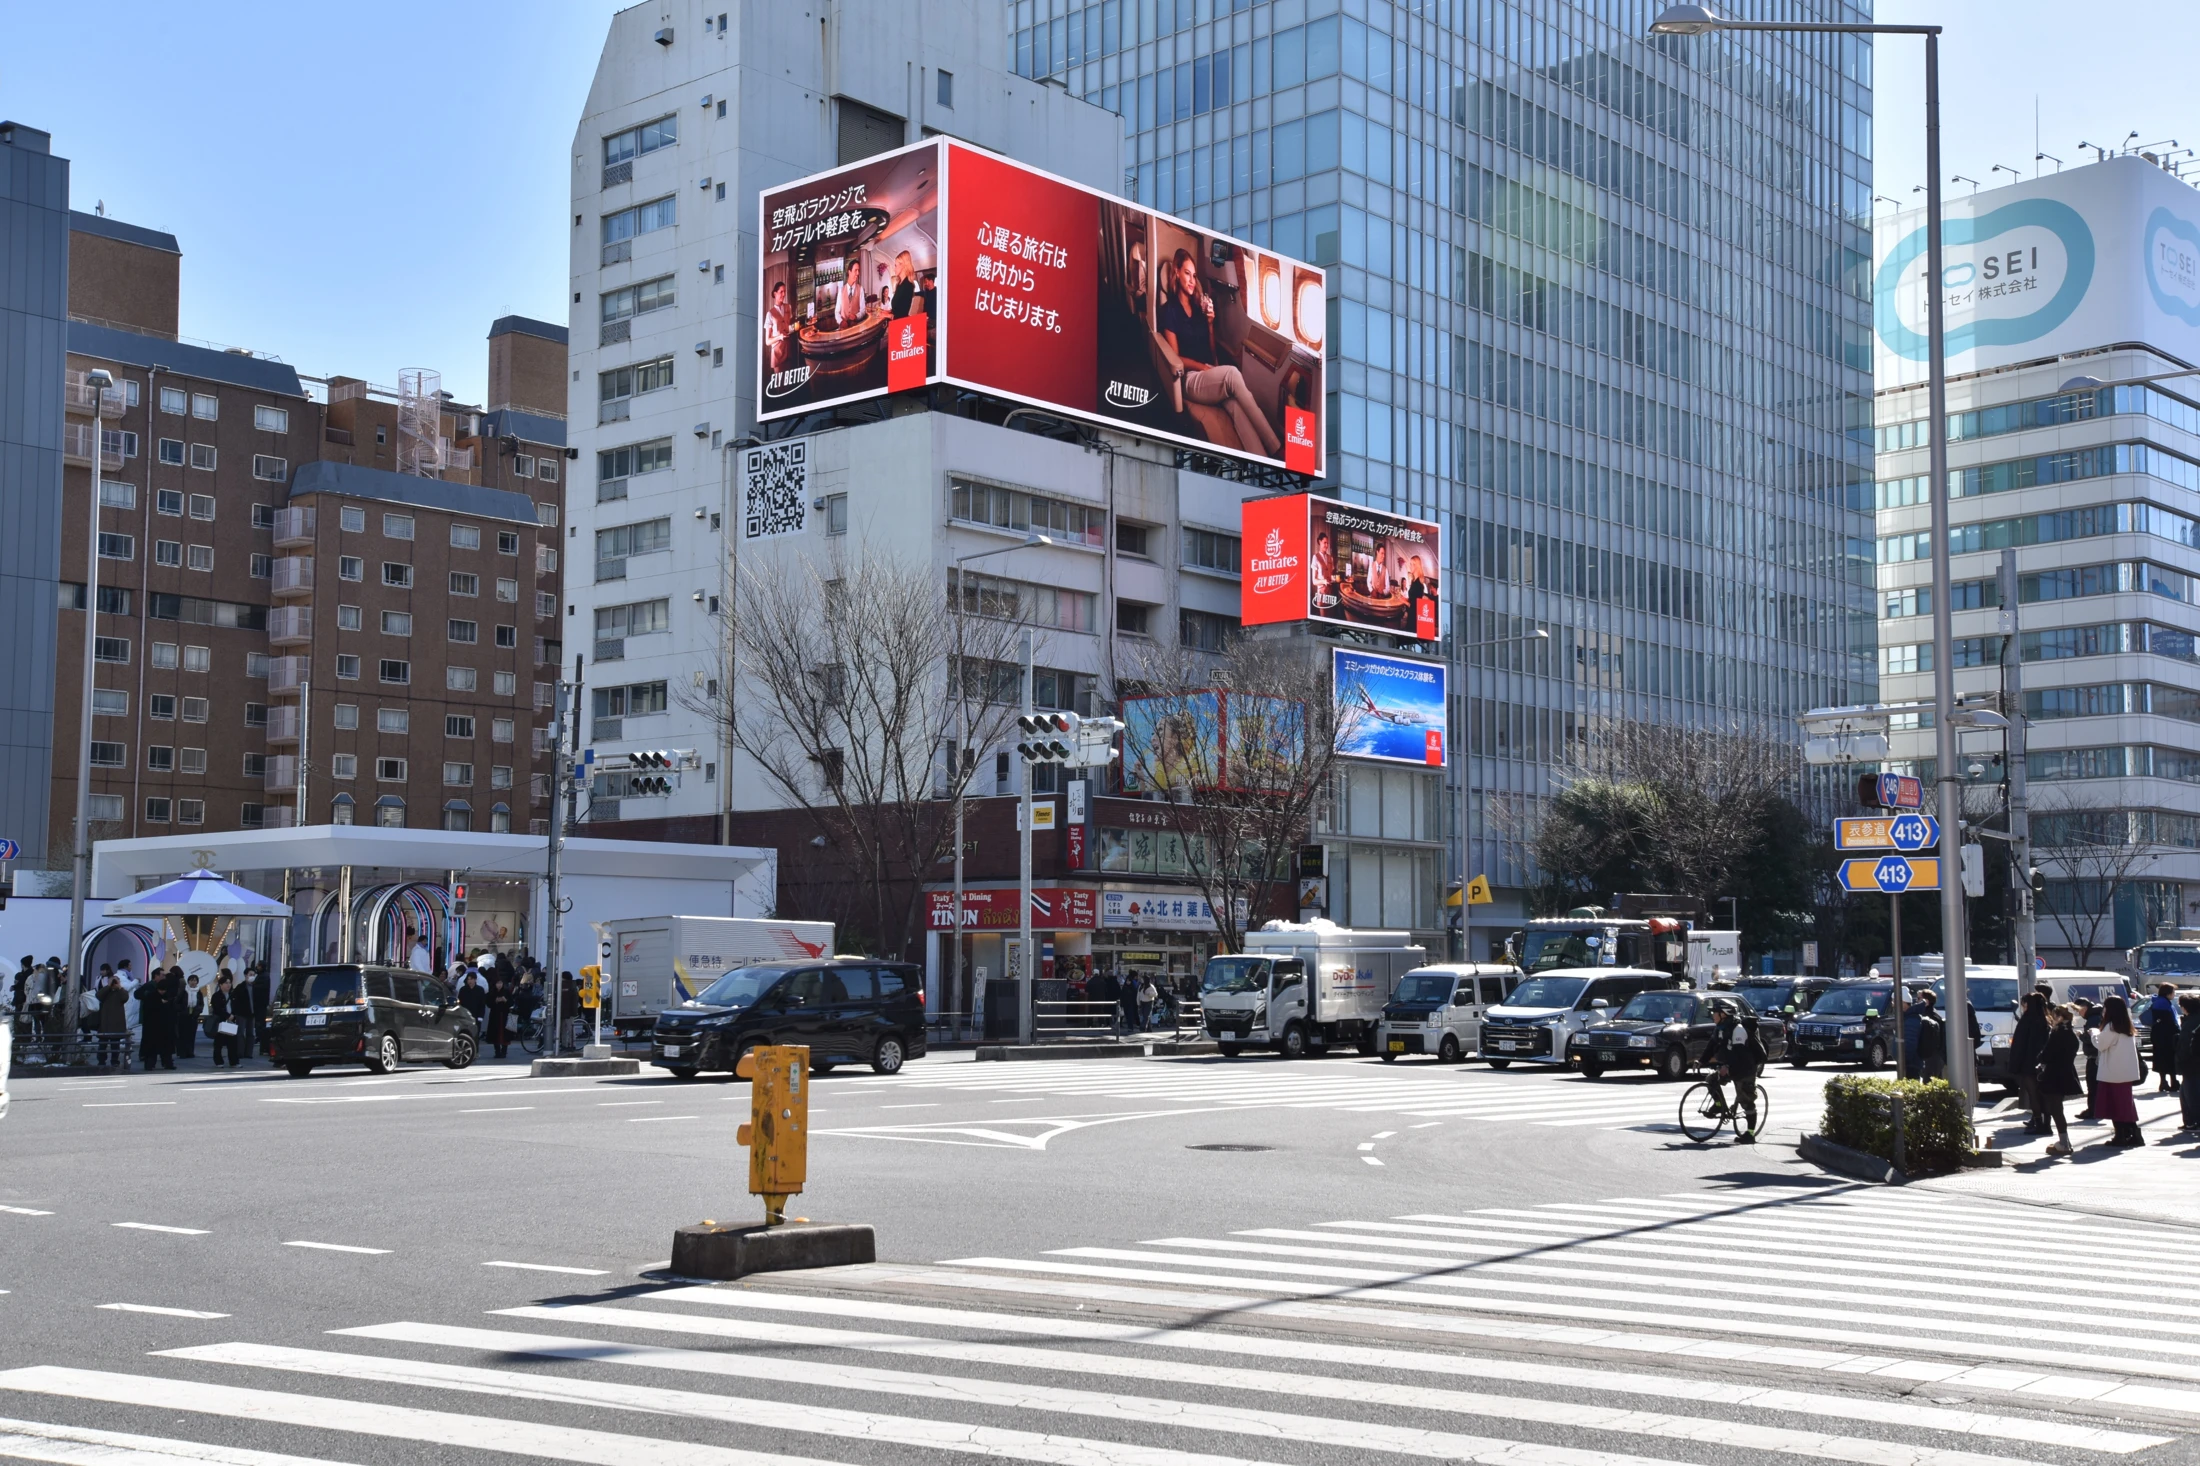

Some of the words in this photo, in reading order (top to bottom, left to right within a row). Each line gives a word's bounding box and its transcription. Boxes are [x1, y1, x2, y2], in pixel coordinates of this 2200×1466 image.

[772, 184, 867, 230] 空飛ぶラウンジで、
[771, 209, 866, 252] カクテルや軽食を。
[977, 221, 1067, 269] 心躍る旅行は
[975, 253, 1035, 292] 機内から
[974, 287, 1062, 334] はじまります。
[890, 344, 925, 361] Emirates
[769, 371, 783, 390] FLY
[783, 365, 811, 387] BETTER
[1109, 380, 1122, 397] FLY
[1122, 383, 1149, 404] BETTER
[1287, 433, 1313, 448] Emirates
[1325, 511, 1425, 544] 空飛ぶラウンジで、カクテルや軽食を。
[1251, 555, 1298, 572] Emirates
[1257, 577, 1267, 588] FLY
[1267, 573, 1290, 587] BETTER
[1885, 778, 1898, 795] 246
[1849, 822, 1886, 837] 表参道
[1894, 823, 1923, 842] 413
[1878, 864, 1907, 884] 413
[932, 893, 950, 903] Tasty
[968, 892, 992, 902] Dining
[1073, 892, 1089, 900] Tasty
[1073, 908, 1094, 917] Dining
[1156, 899, 1212, 918] 北村薬局
[624, 954, 640, 963] SEINO
[1332, 972, 1355, 983] DyDo
